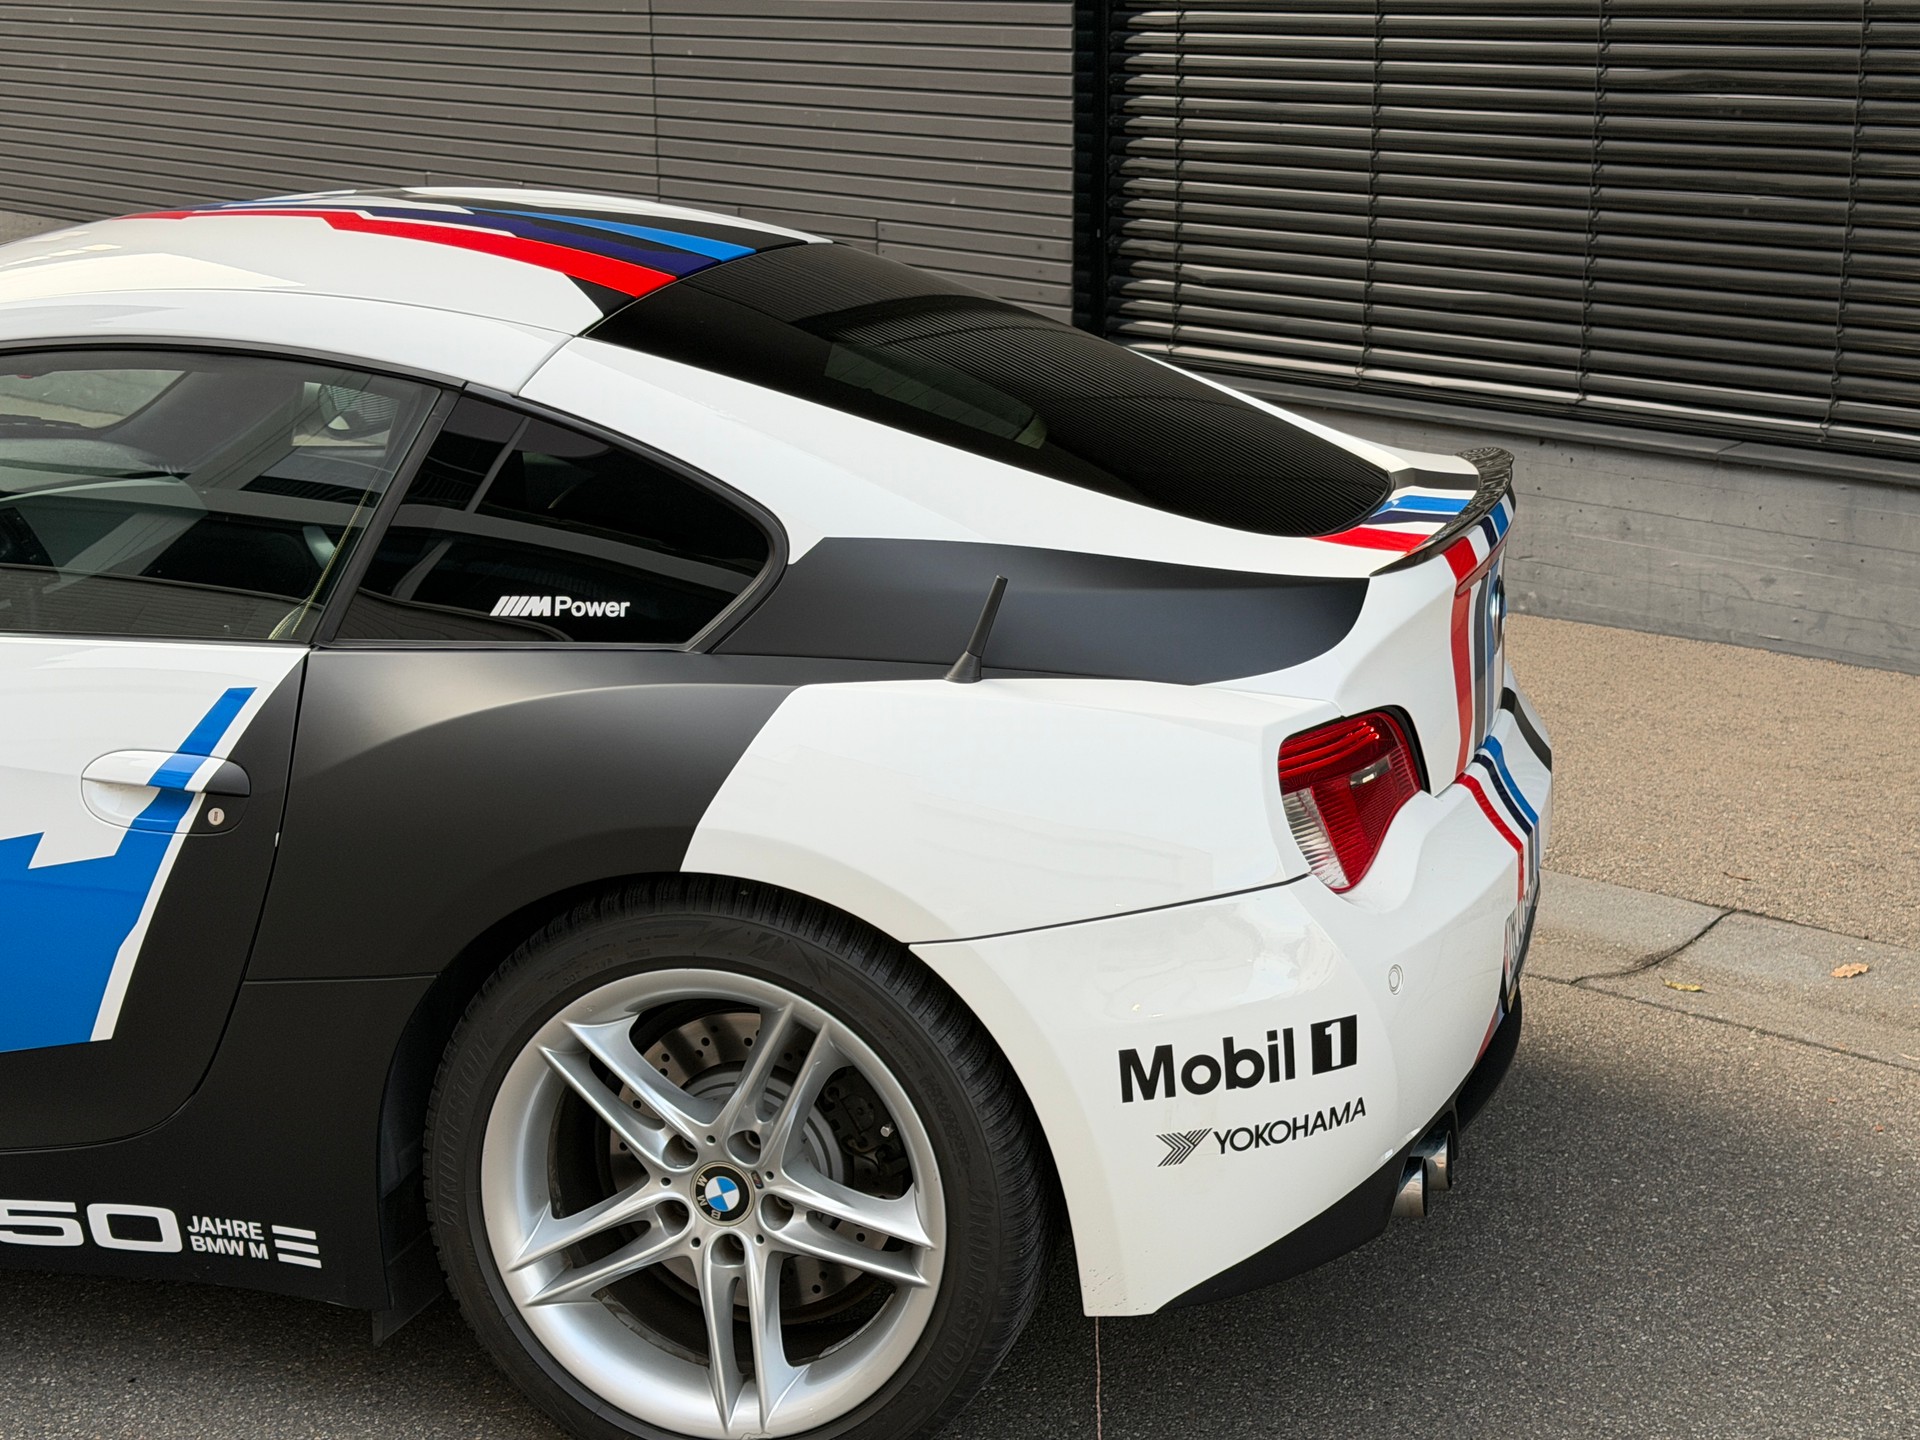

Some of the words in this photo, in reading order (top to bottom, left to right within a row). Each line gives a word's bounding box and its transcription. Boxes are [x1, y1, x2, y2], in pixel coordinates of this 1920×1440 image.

[554, 596, 631, 618] Power
[1118, 1027, 1296, 1103] Mobil
[1213, 1097, 1366, 1154] YOKOHAMA
[0, 1199, 183, 1253] 50
[187, 1215, 265, 1241] JAHRE
[189, 1235, 244, 1257] BMW
[249, 1242, 269, 1260] M
